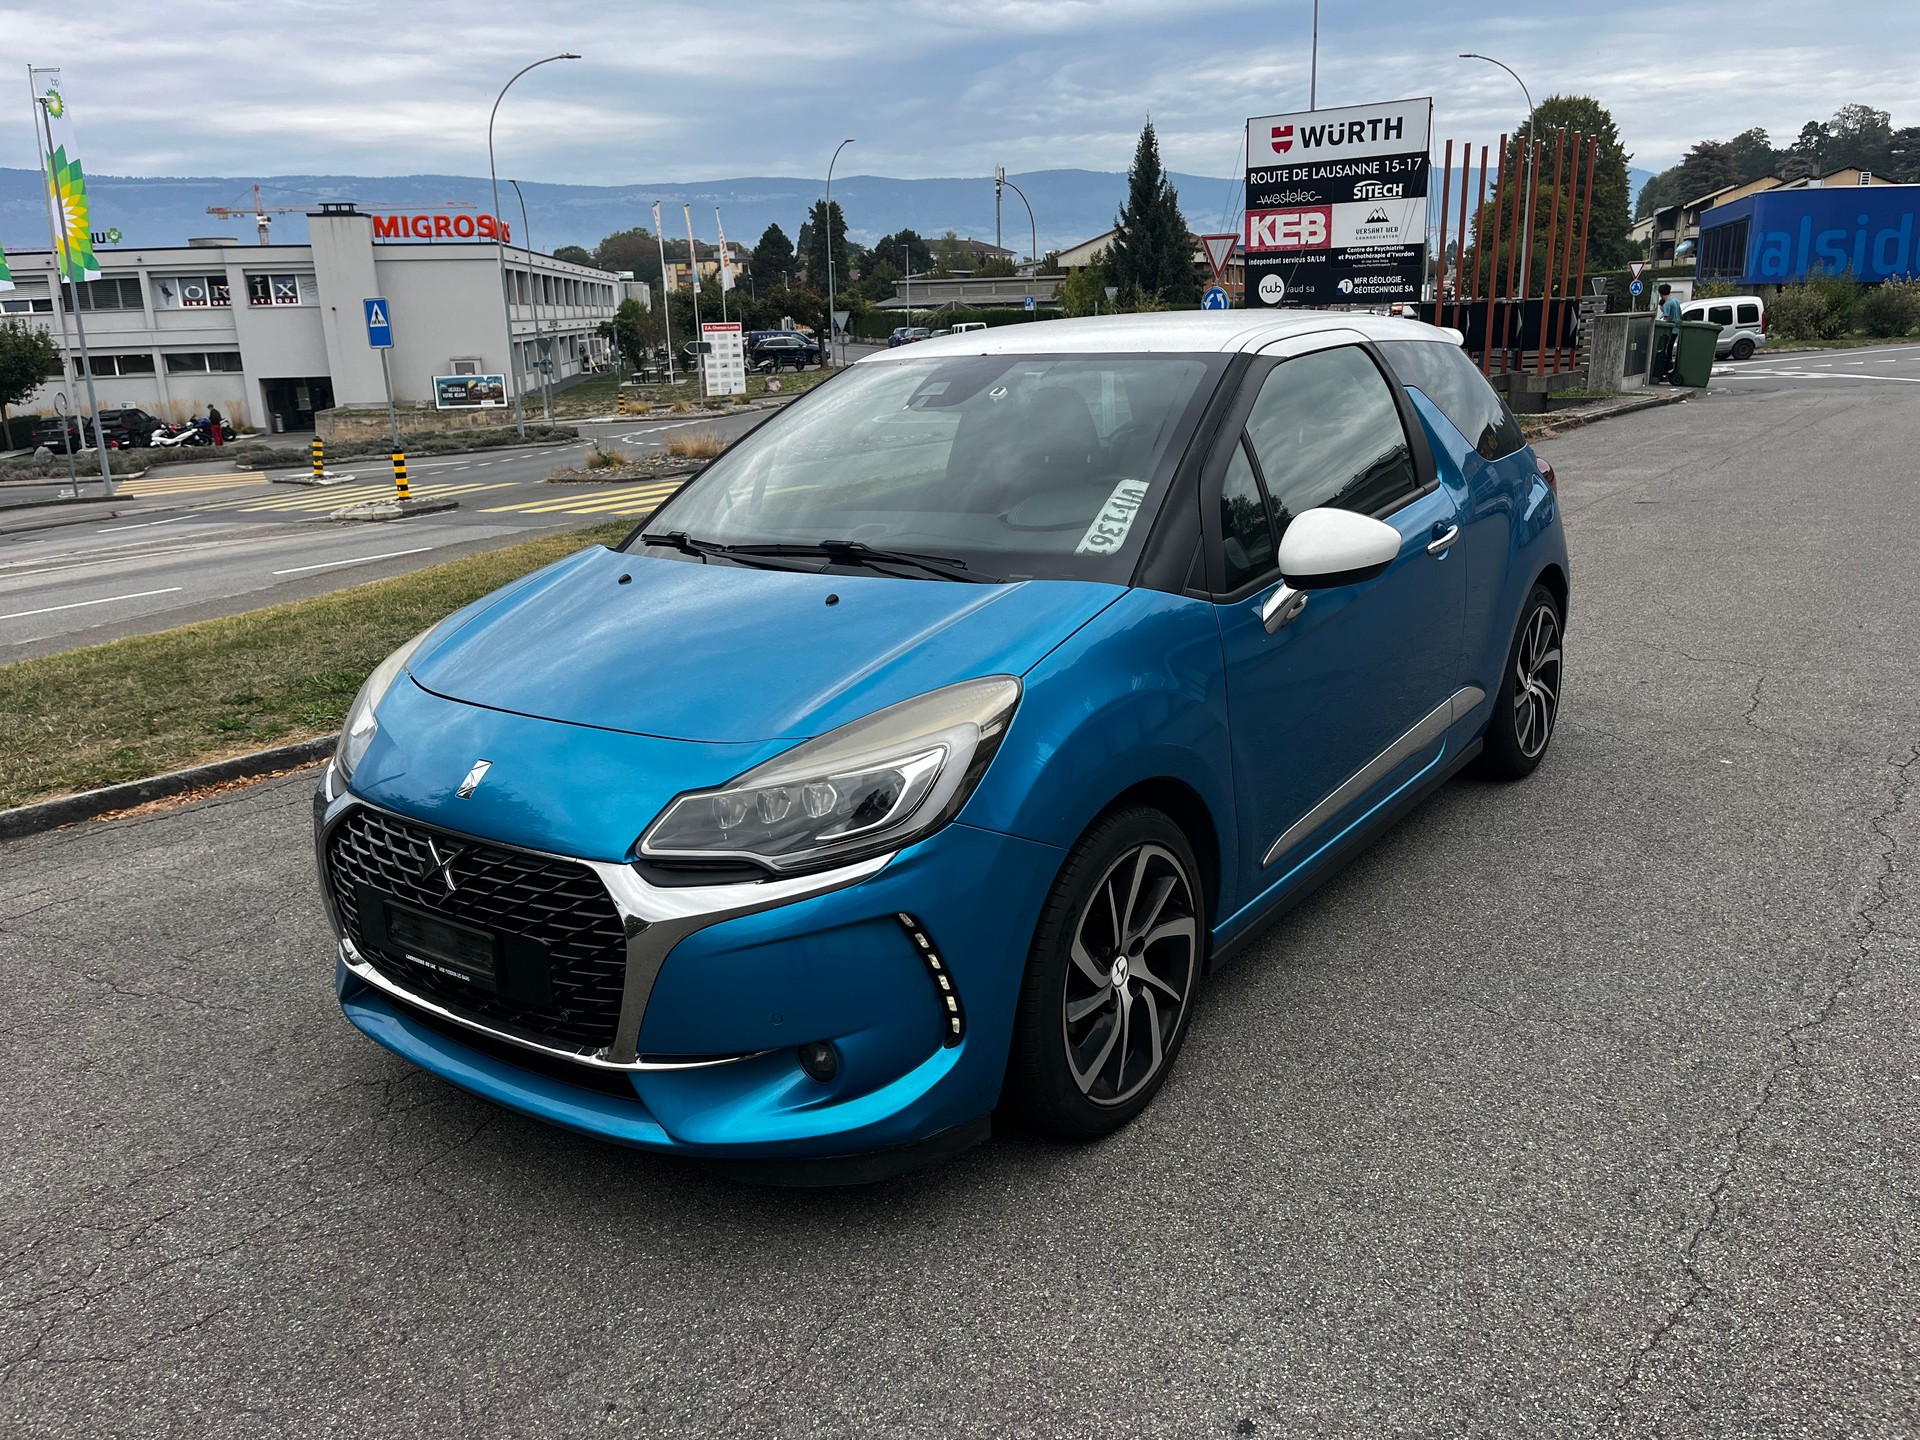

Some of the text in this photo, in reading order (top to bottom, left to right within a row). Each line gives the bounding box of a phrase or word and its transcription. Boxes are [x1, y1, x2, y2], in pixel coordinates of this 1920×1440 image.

[1300, 117, 1403, 148] WÜRTH
[1250, 157, 1422, 185] ROUTE DE LAUSANNE 15-17
[1257, 188, 1322, 205] westelec
[1353, 183, 1404, 199] SITECH
[372, 214, 495, 238] MIGROS
[1250, 212, 1327, 247] KEB
[1355, 227, 1384, 235] VERSANT
[1374, 245, 1404, 253] Psychiatrie
[1749, 212, 1920, 278] valsid
[1307, 255, 1326, 263] SA/Ltd
[1345, 251, 1386, 261] Psychothérapie
[1354, 277, 1368, 285] MFR
[1368, 275, 1402, 284] GÉOLOGIE
[1261, 282, 1282, 293] rwb
[1353, 285, 1403, 294] GÉOTECHNIQUE
